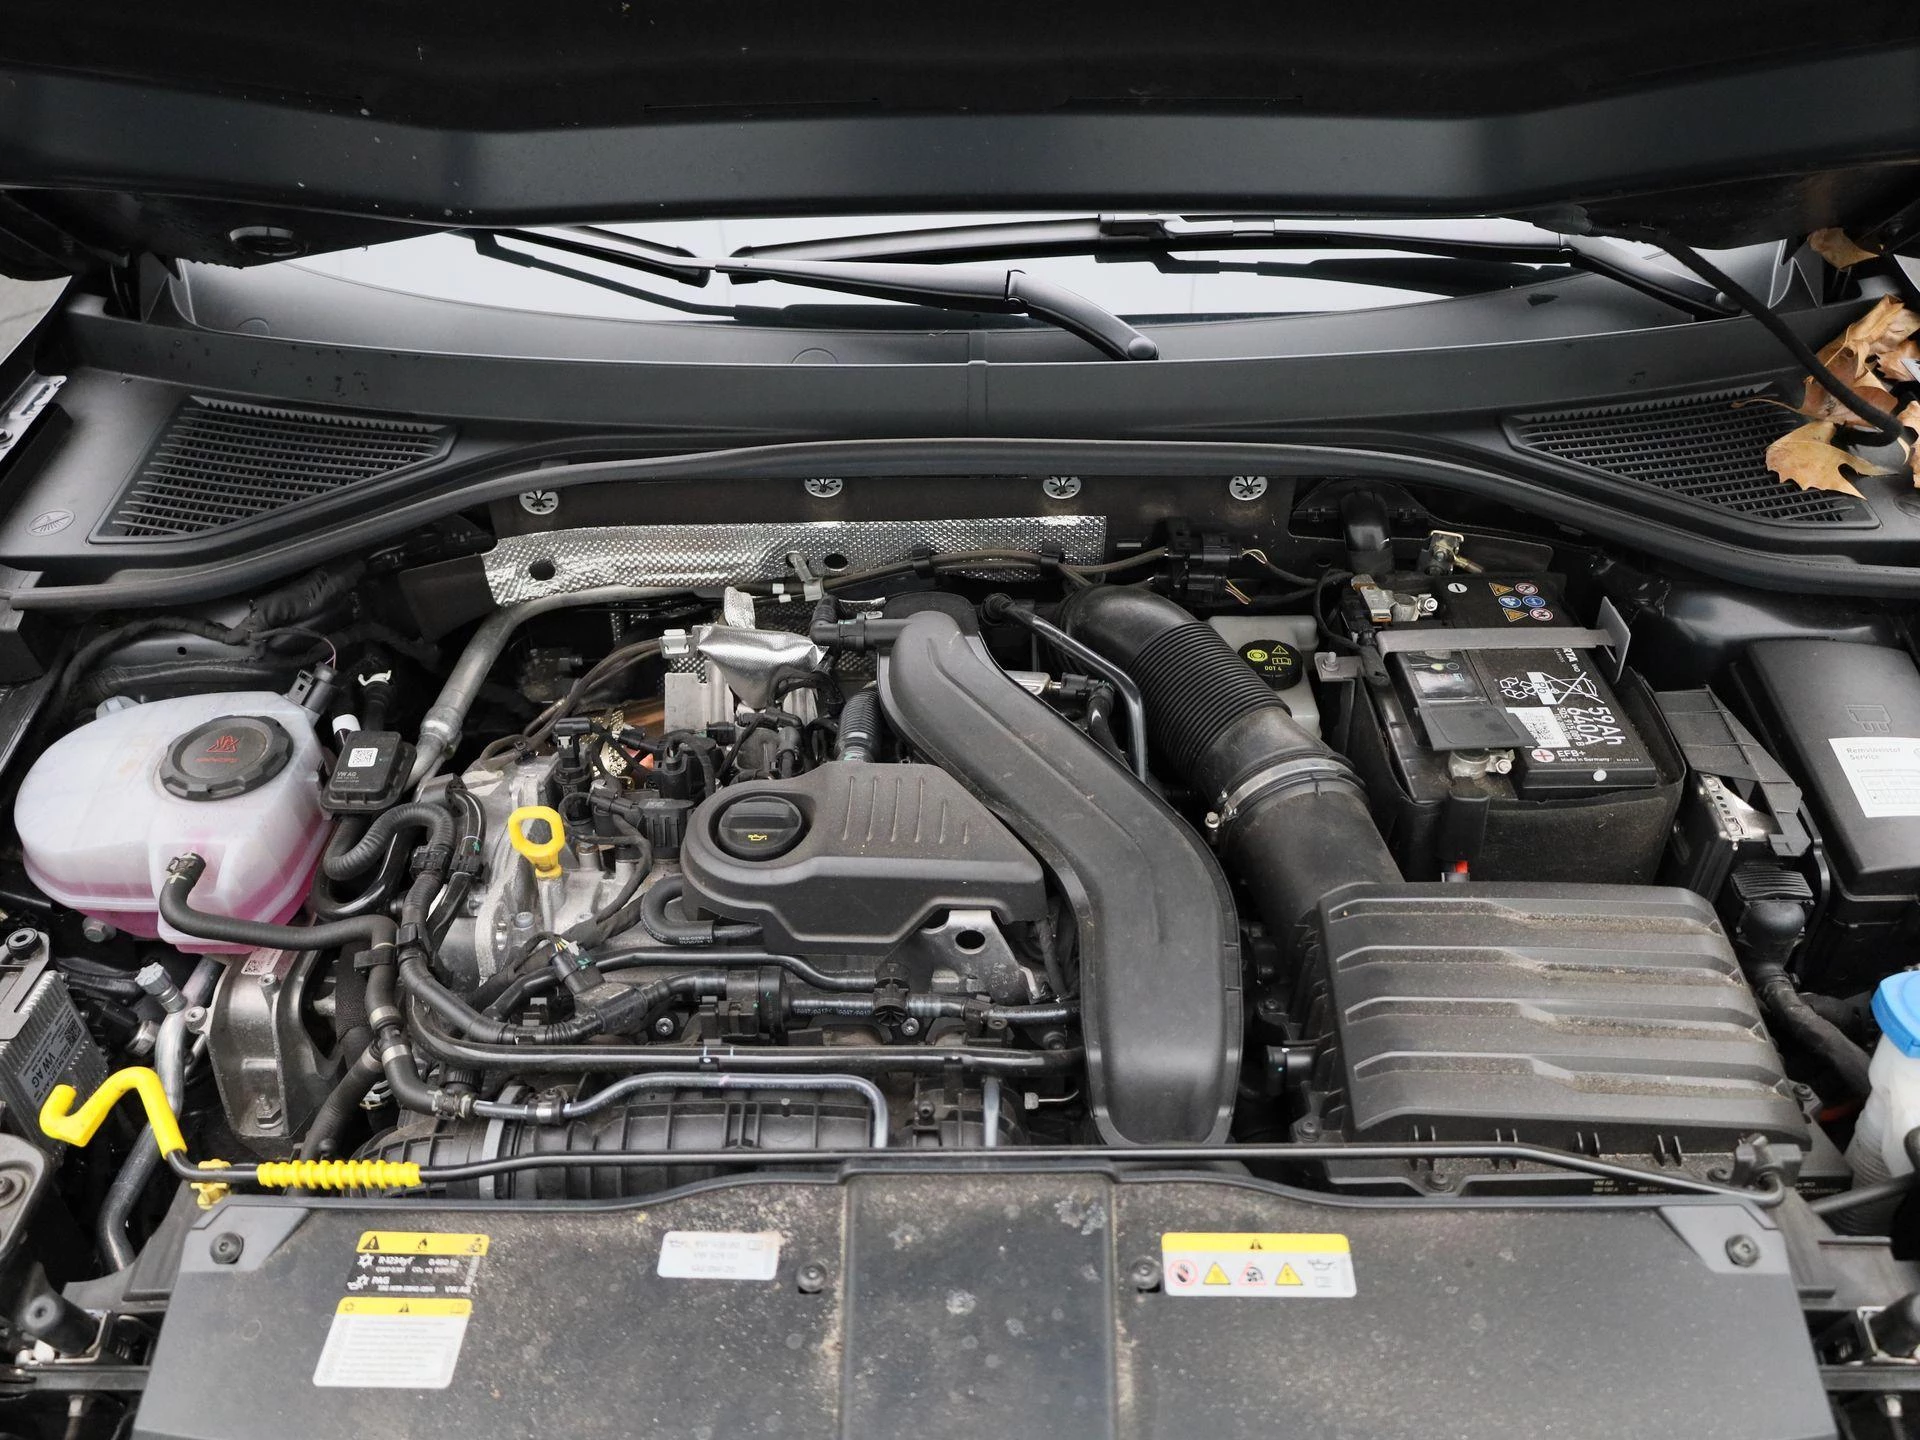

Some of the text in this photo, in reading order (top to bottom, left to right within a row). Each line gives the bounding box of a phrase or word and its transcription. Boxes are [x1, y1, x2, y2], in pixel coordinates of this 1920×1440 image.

[1534, 681, 1547, 695] Pb
[1567, 707, 1605, 745] 640A
[1556, 749, 1586, 757] EFB+
[42, 1052, 56, 1072] VW
[31, 1069, 44, 1088] AG
